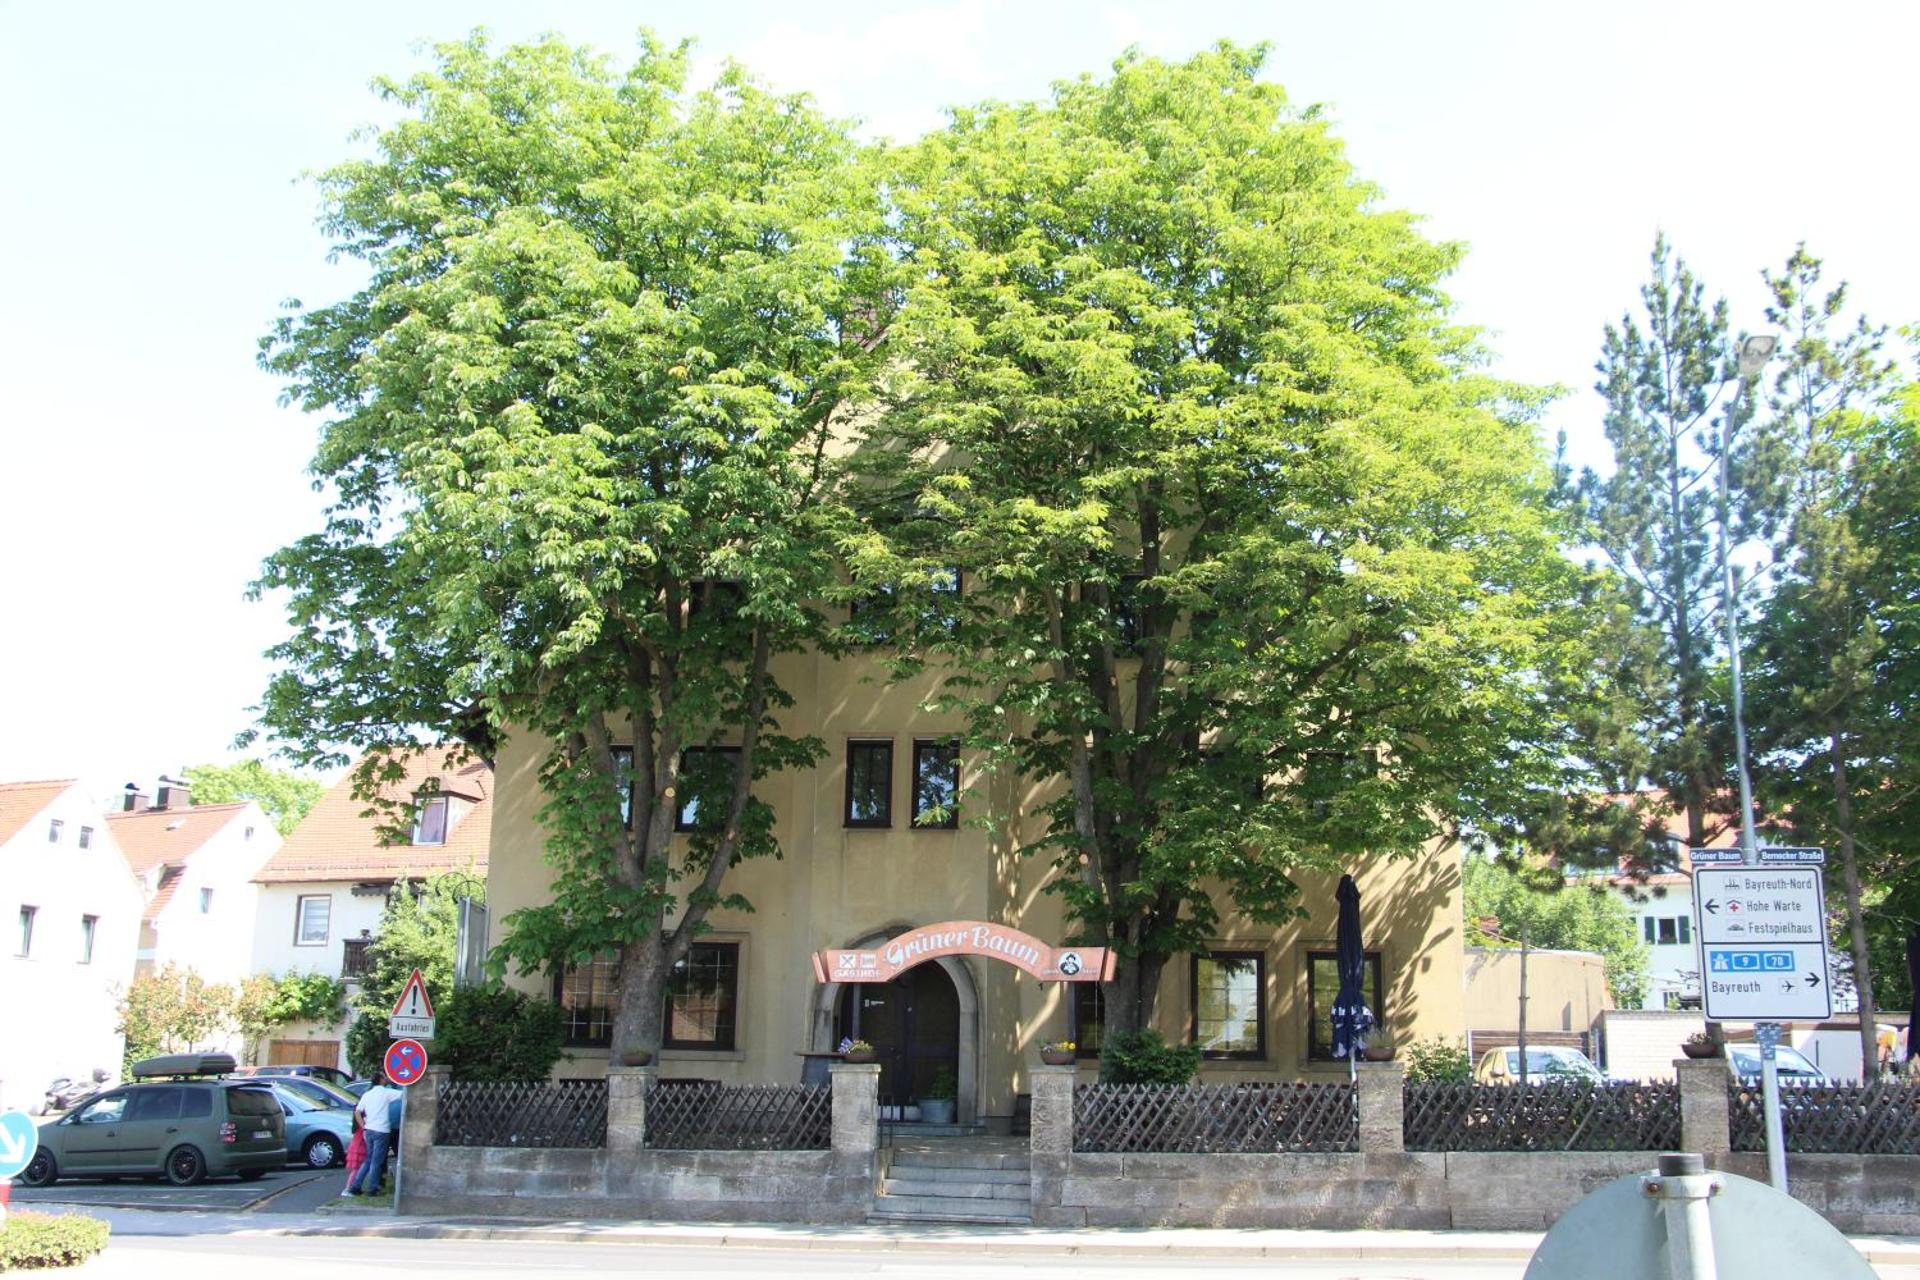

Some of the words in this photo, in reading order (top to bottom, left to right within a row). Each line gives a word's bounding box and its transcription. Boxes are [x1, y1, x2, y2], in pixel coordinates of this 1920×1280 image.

[1690, 851, 1716, 860] Grüner
[1799, 851, 1822, 860] Straße
[1745, 879, 1812, 892] Bayreuth-Nord
[1746, 902, 1769, 912] Hohe
[1773, 902, 1801, 912] Warte
[1748, 922, 1813, 935] Festspielhaus
[886, 930, 968, 969] Grüner
[972, 926, 1039, 966] Baum
[1742, 955, 1749, 966] 9
[1712, 981, 1761, 995] Bayreuth
